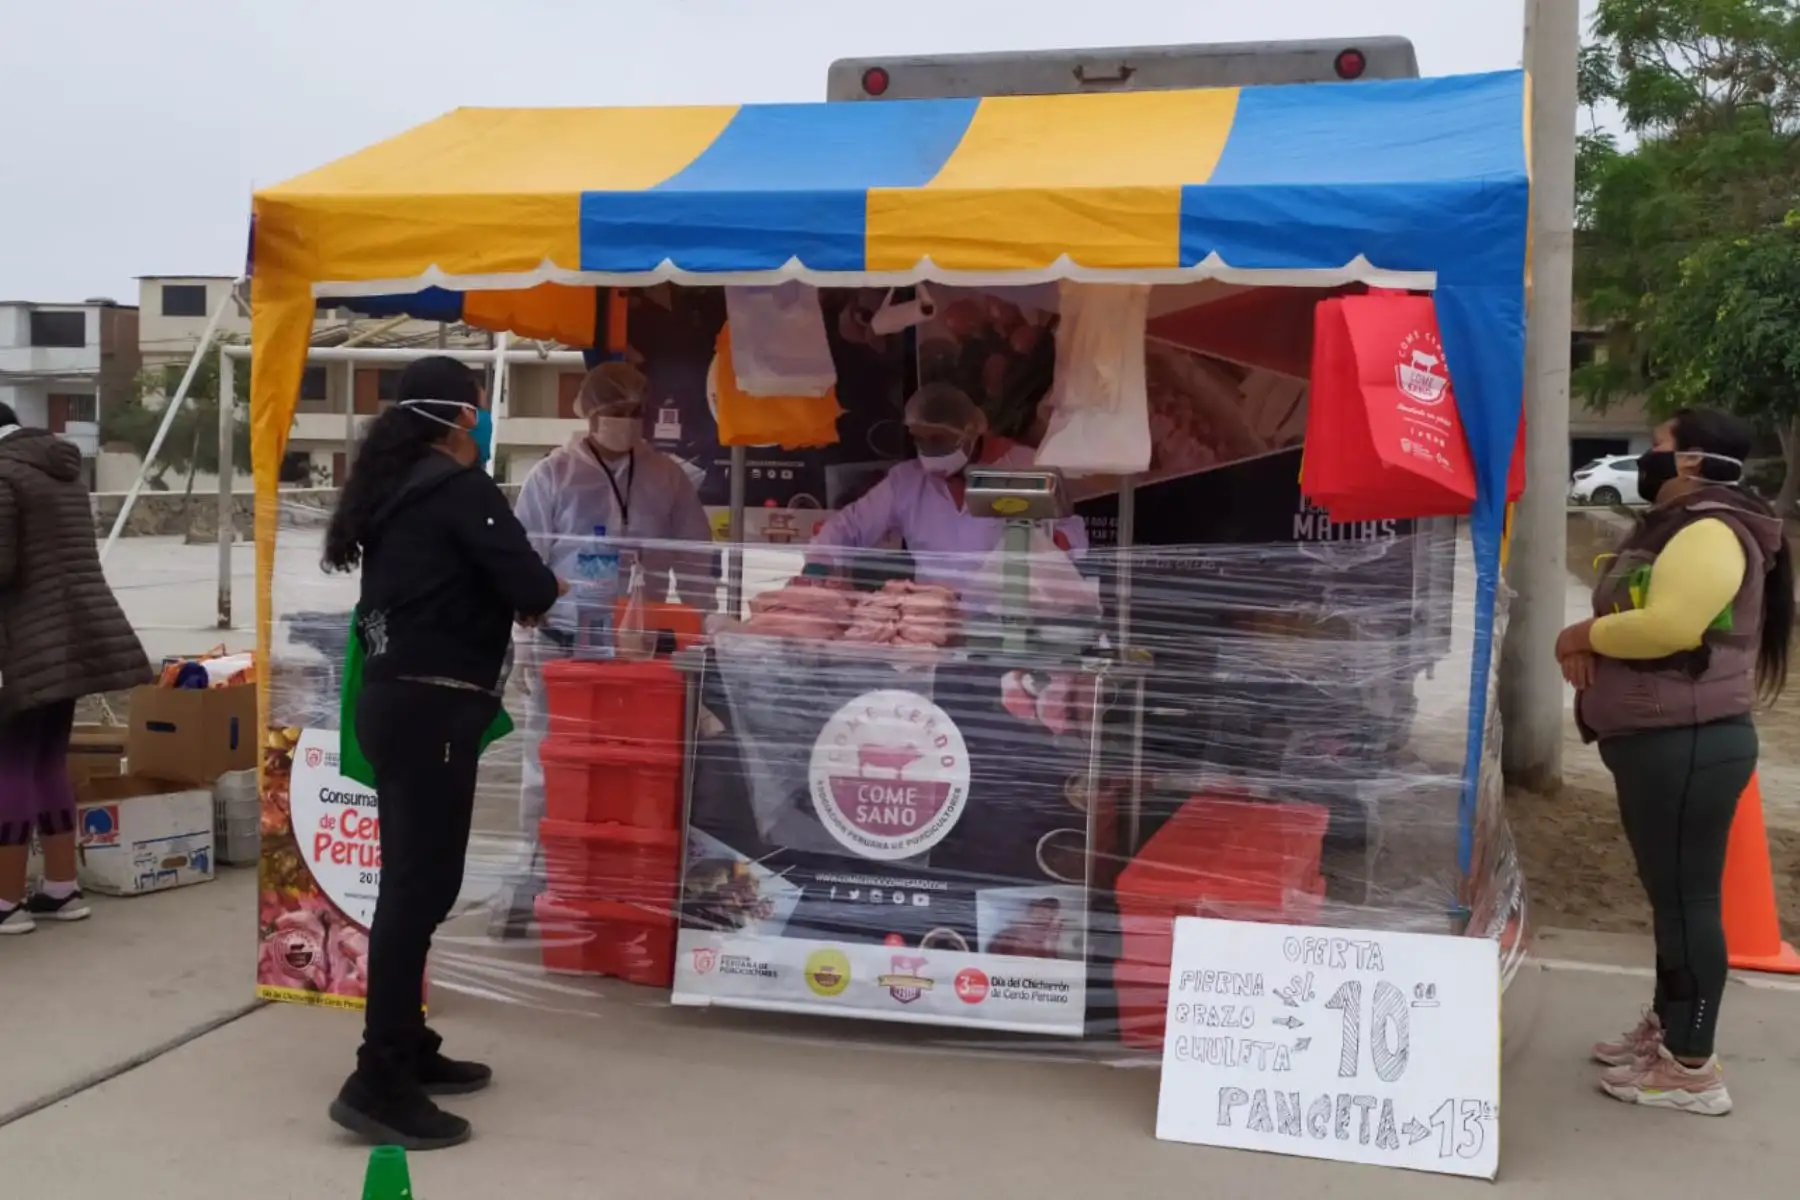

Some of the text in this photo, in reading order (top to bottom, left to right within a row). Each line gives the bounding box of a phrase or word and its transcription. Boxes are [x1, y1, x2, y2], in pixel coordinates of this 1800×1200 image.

[893, 704, 956, 768] CERDO
[857, 784, 917, 806] COME
[319, 808, 380, 841] de Cer
[856, 805, 917, 827] SANO
[359, 871, 379, 884] 201
[1282, 936, 1385, 971] OFERTA
[1002, 989, 1030, 1000] Cerdo
[1007, 978, 1020, 989] del
[1175, 1003, 1255, 1029] BRAZO
[1178, 970, 1265, 997] PIERNA
[1325, 980, 1410, 1083] 10
[1175, 1035, 1291, 1072] CHULETA
[1216, 1086, 1401, 1151] PANCETA
